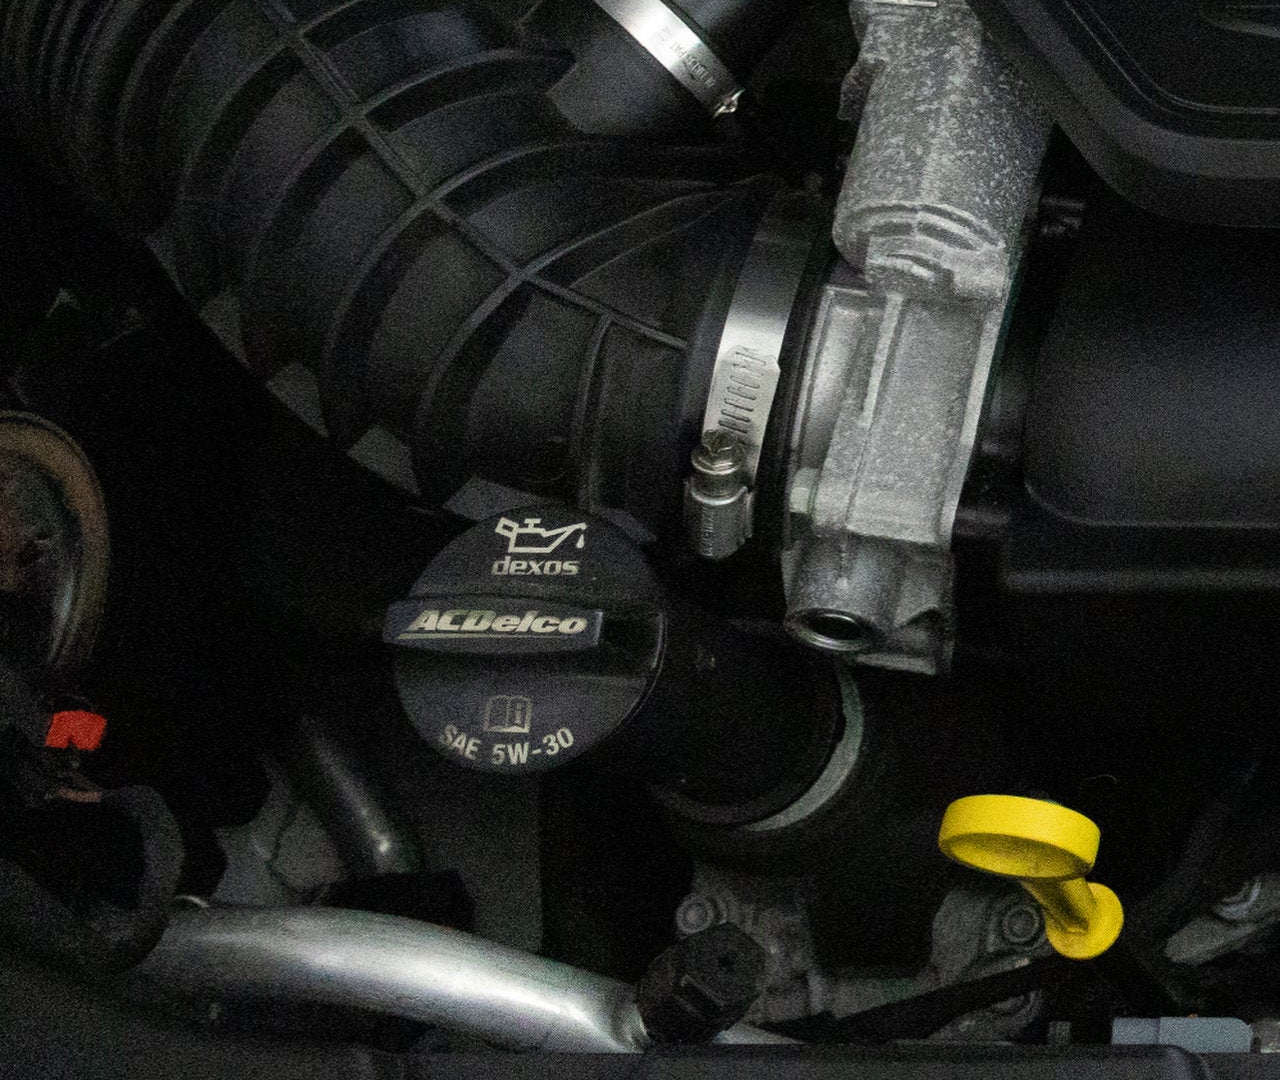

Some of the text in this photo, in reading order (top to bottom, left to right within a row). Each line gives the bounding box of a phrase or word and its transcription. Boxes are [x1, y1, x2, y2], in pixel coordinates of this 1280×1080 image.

[491, 556, 580, 576] dexos
[405, 610, 588, 635] ACDelco
[440, 724, 575, 765] SAE 5W-30
